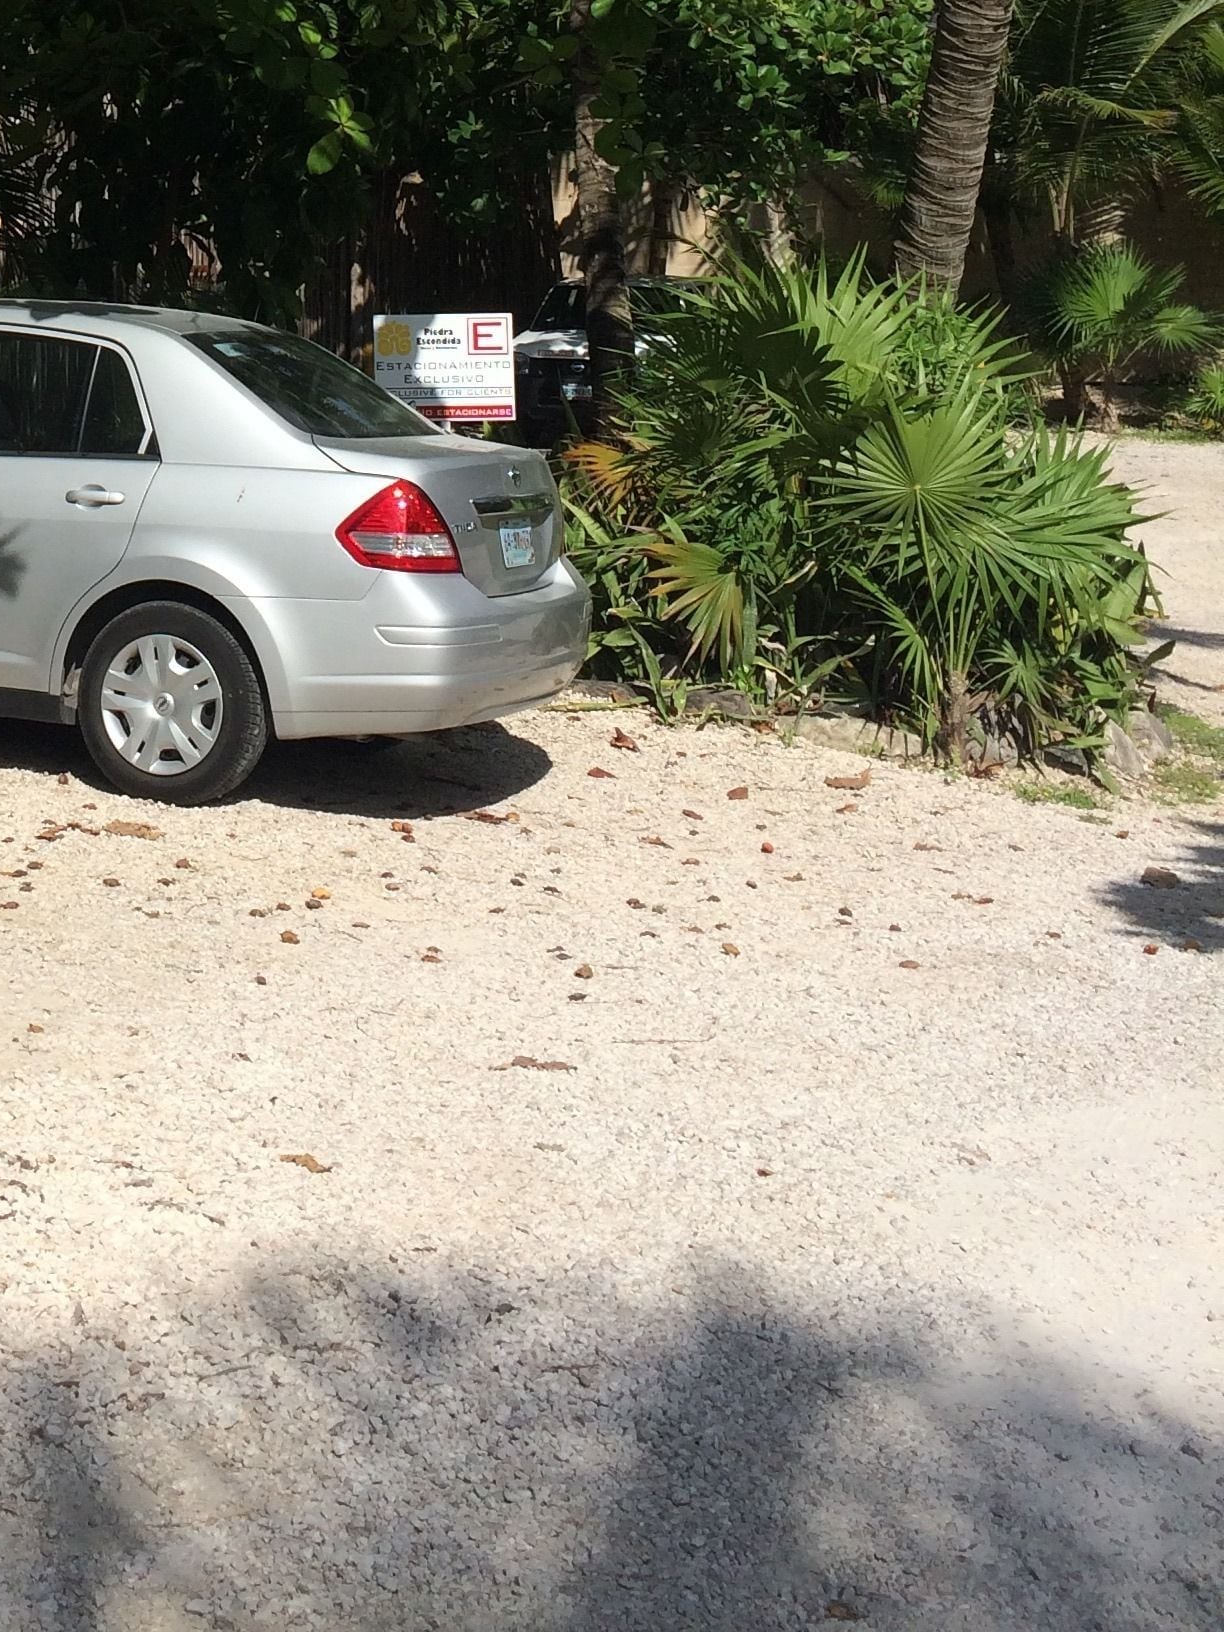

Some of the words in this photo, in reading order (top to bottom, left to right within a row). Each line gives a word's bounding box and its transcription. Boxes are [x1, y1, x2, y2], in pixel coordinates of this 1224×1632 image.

[423, 327, 453, 336] Piedra
[473, 322, 503, 351] E
[416, 337, 461, 346] Escondida
[376, 361, 511, 371] ESTACIONAMIENTO
[404, 374, 484, 384] EXCLUSIVO
